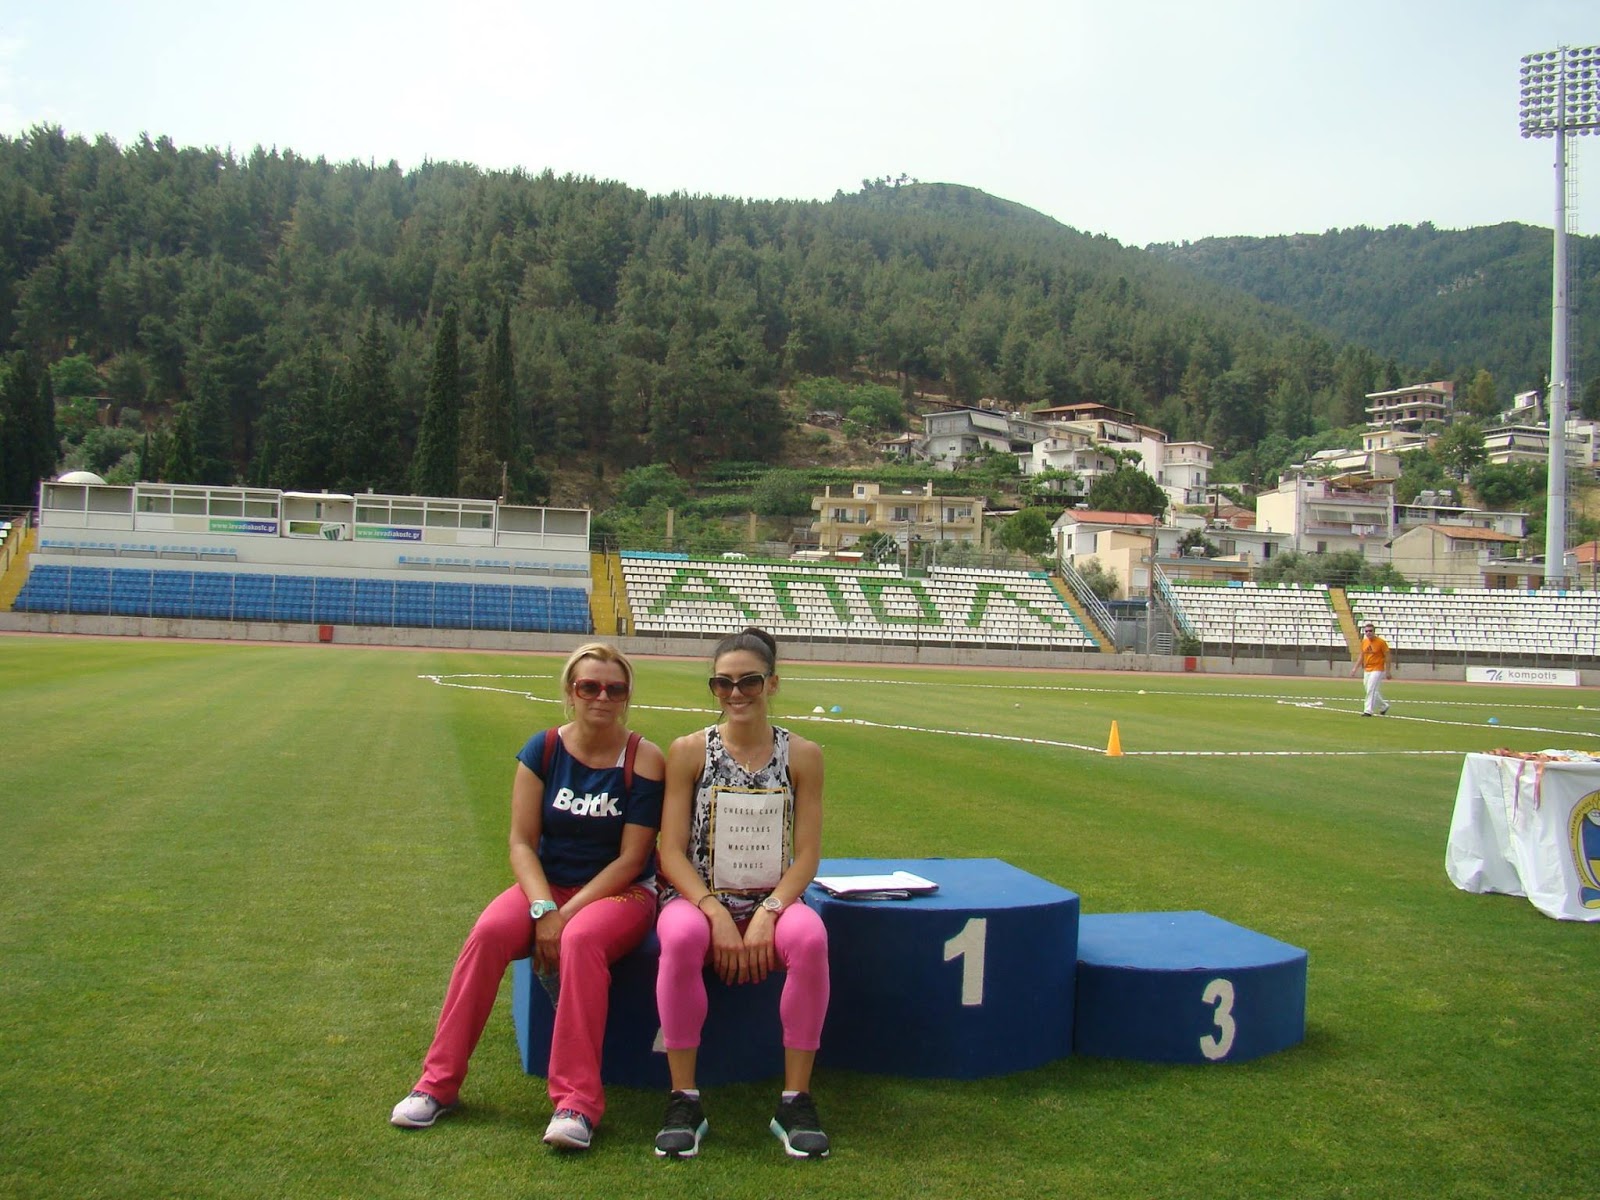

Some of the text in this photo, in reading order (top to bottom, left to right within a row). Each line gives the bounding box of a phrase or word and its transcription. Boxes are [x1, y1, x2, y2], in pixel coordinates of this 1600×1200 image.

[1508, 670, 1557, 680] kompotis
[723, 807, 754, 816] CHEESE
[943, 917, 987, 1006] 1
[1200, 978, 1236, 1061] 3
